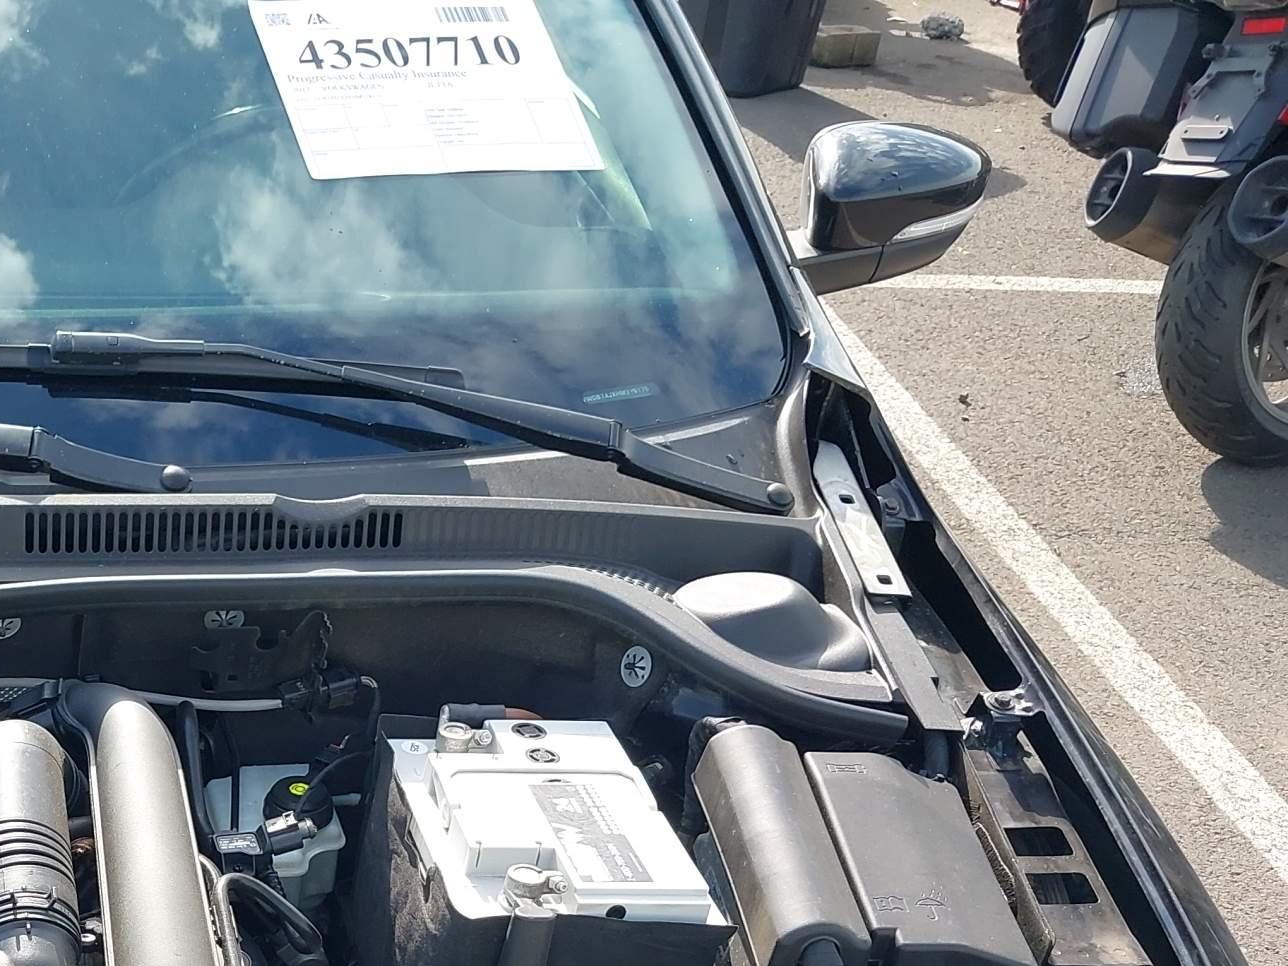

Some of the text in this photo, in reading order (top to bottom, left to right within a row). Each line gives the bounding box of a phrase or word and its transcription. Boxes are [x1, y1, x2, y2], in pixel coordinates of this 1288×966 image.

[298, 35, 521, 70] 43507710
[287, 68, 468, 85] Progressive Casualty Insurance
